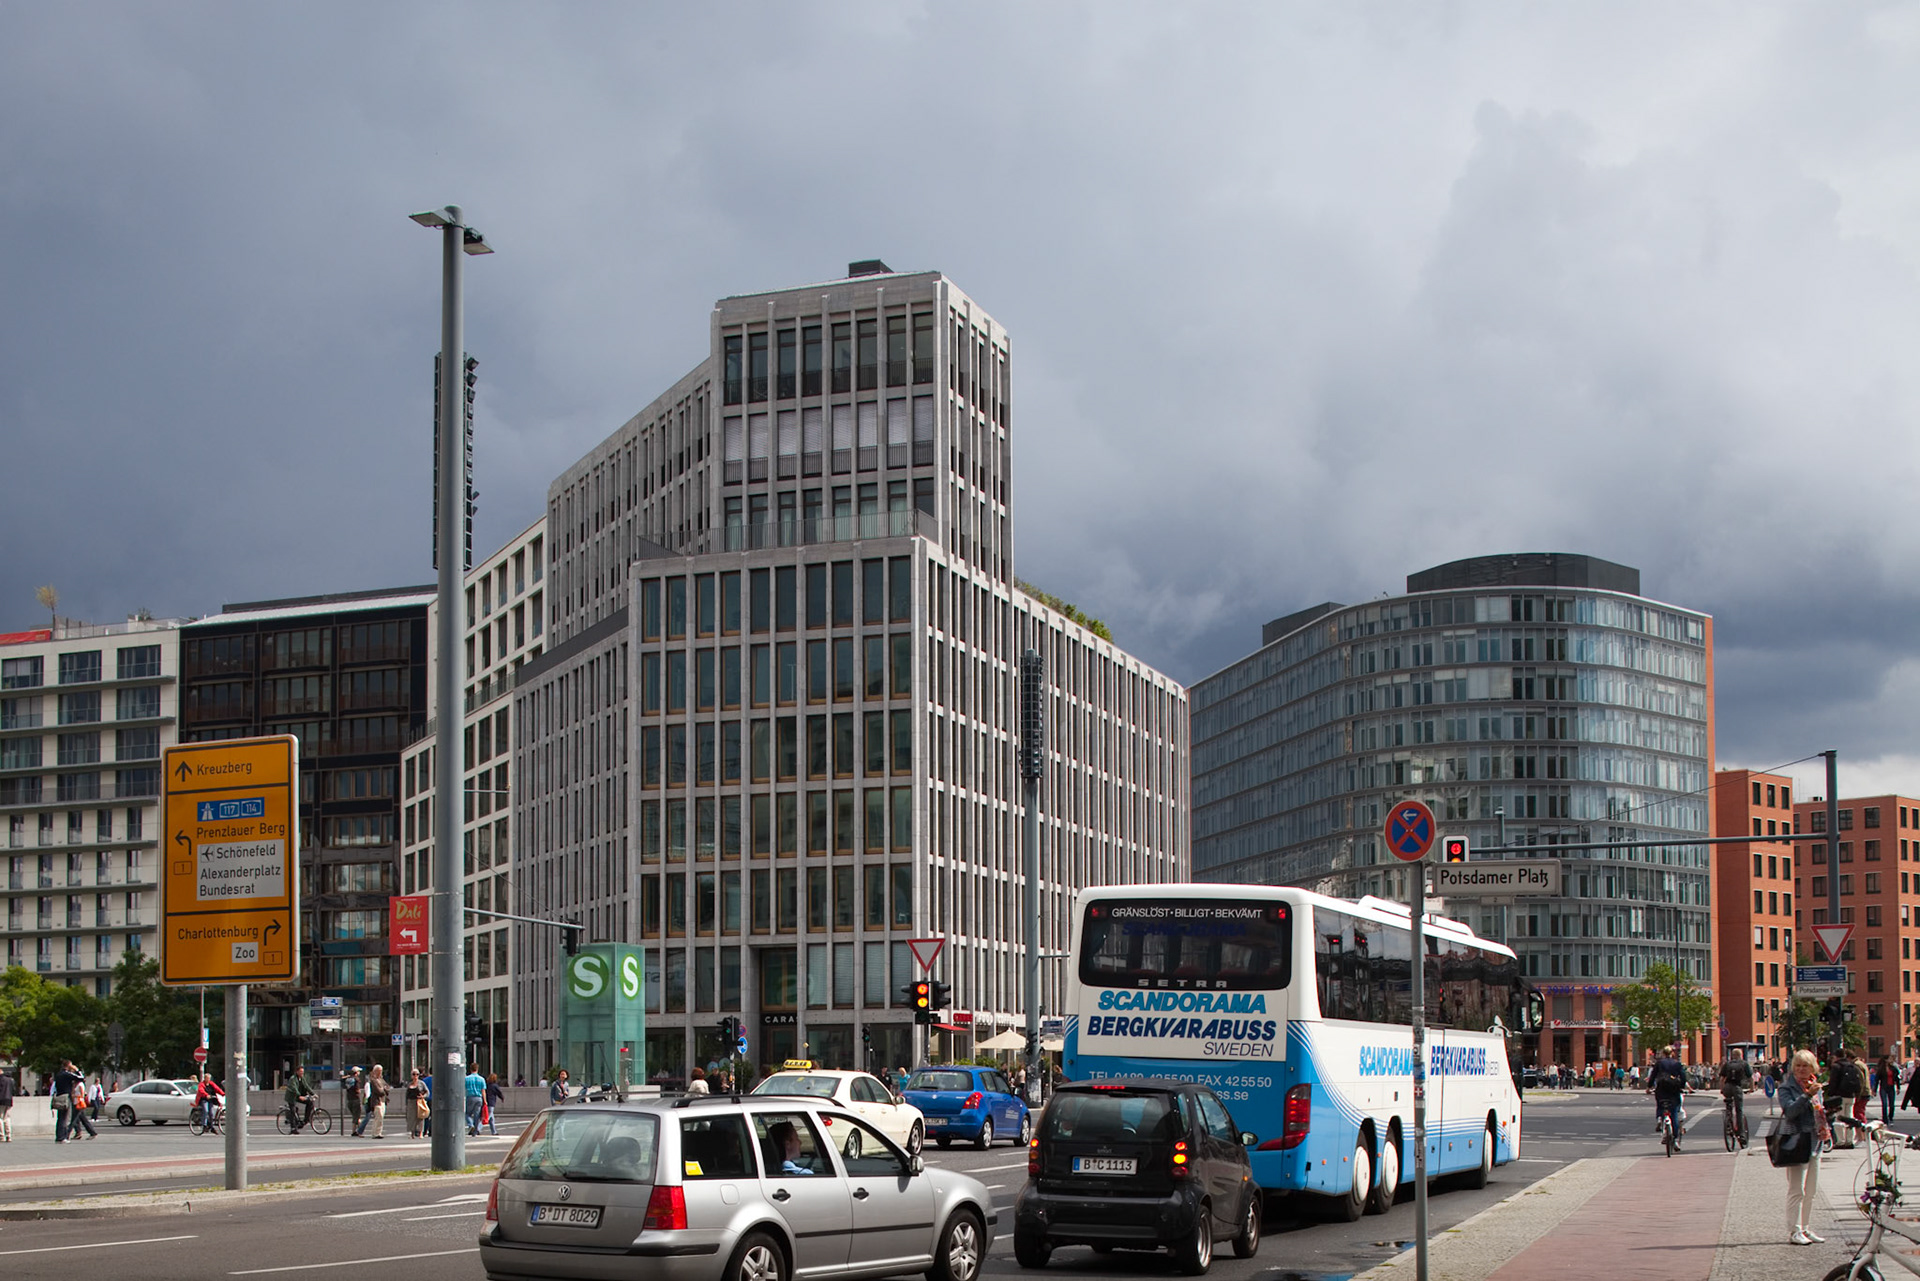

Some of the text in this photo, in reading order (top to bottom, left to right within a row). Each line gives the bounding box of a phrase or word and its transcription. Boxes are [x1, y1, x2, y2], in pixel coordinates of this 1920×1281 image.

[197, 761, 252, 776] Kreuzberg
[223, 802, 257, 816] 117 114
[196, 823, 286, 839] Prenzlauer Berg
[216, 844, 276, 859] Schönefeld
[200, 865, 281, 880] Alexanderplatz
[1440, 868, 1549, 888] Potsdamer Platz
[199, 883, 255, 897] Bundesrat
[178, 925, 259, 940] Charlottenburg
[235, 947, 255, 959] Zoo
[573, 956, 603, 997] S
[622, 956, 639, 997] S
[1138, 978, 1227, 988] SETRA
[1098, 990, 1267, 1014] SCANDORAMA
[764, 1015, 798, 1024] CARA
[1630, 1015, 1640, 1030] S
[1087, 1015, 1277, 1041] BERGKVARABUSS
[1203, 1042, 1274, 1057] SWEDEN
[1430, 1045, 1486, 1076] BERGKVARABUSS
[1197, 1074, 1222, 1086] FAX
[1083, 1159, 1091, 1170] B
[538, 1207, 598, 1223] B DT 8029
